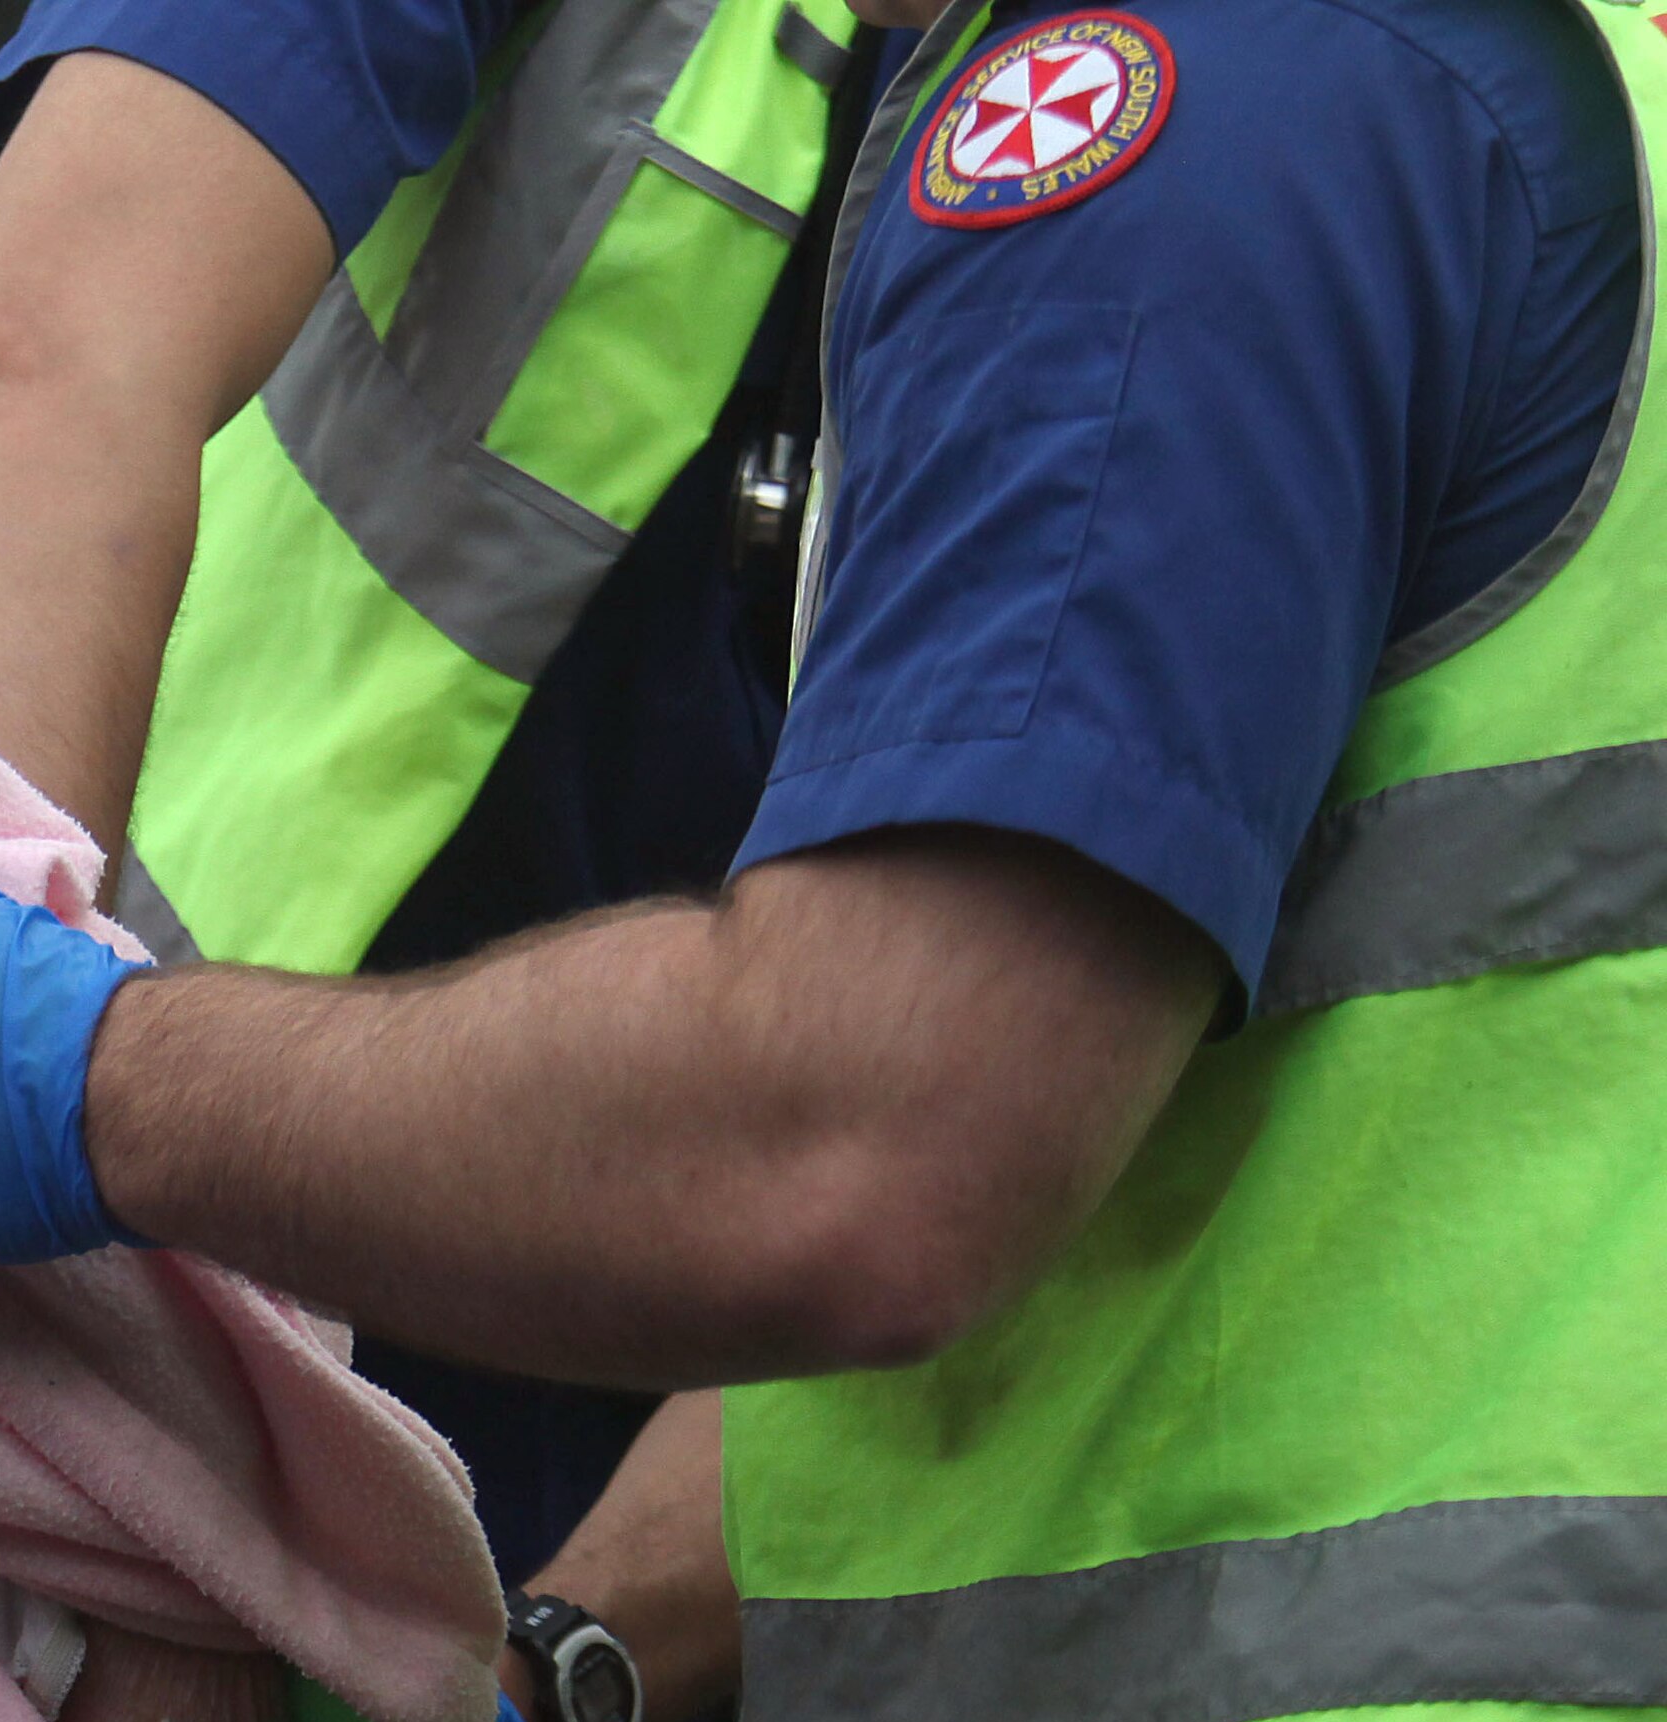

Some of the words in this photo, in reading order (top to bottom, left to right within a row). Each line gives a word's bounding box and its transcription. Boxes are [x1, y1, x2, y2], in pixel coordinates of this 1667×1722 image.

[1068, 22, 1105, 42] OF
[1104, 25, 1151, 66] NEW
[962, 26, 1067, 100] SERVICE
[1110, 64, 1158, 141] SOUTH
[1021, 140, 1119, 201] WALES
